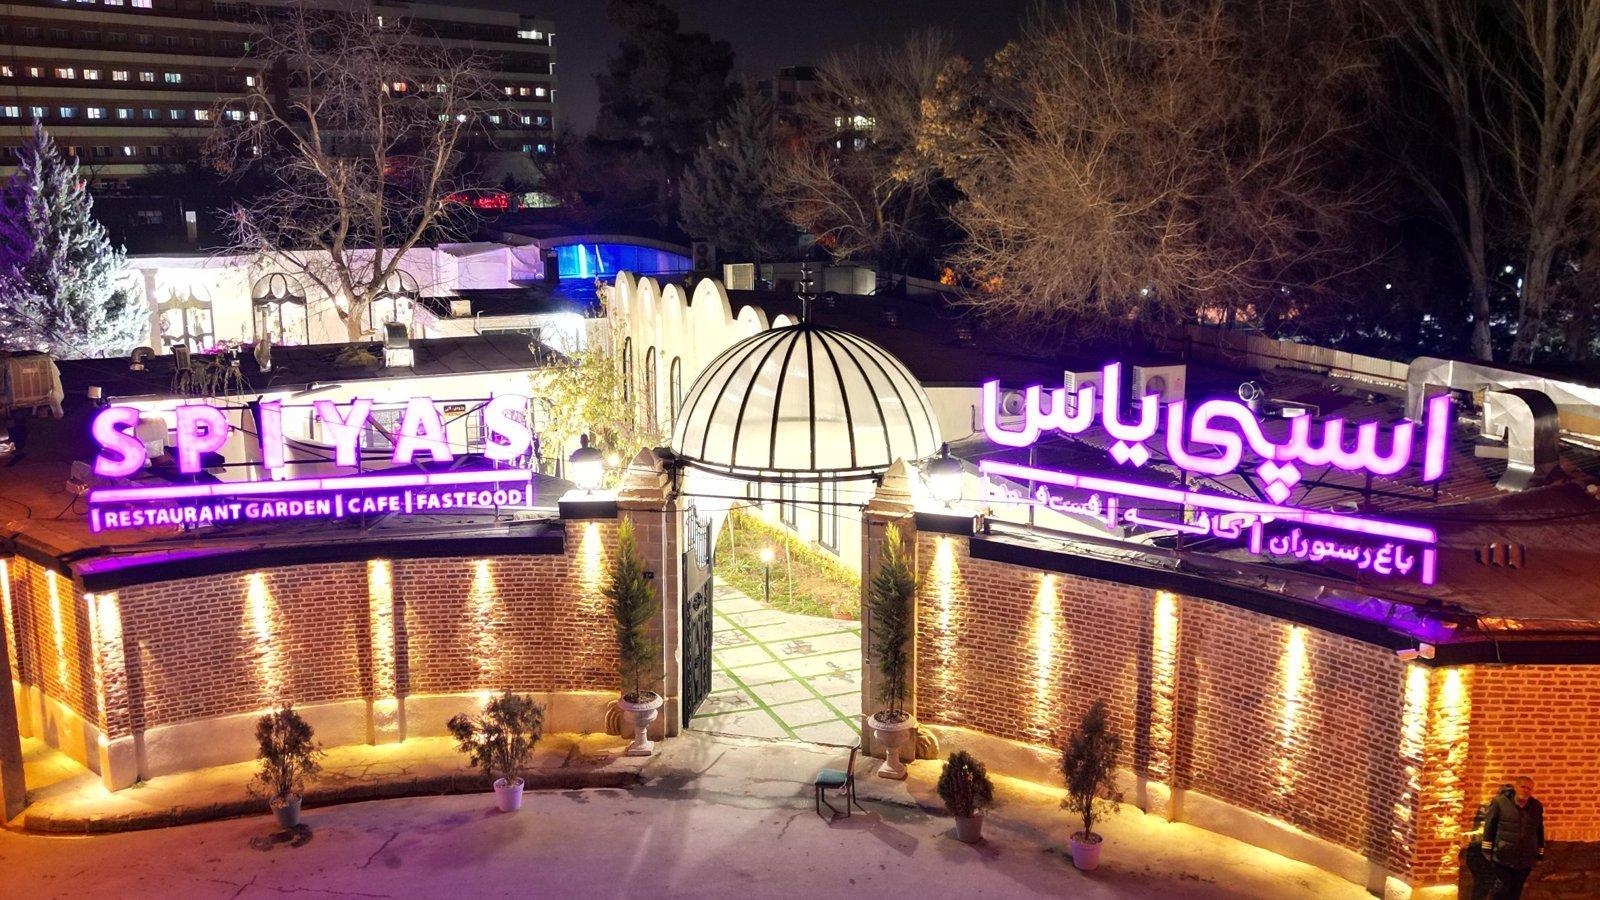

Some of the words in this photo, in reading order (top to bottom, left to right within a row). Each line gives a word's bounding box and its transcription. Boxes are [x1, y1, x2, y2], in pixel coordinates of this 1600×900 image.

[92, 394, 533, 478] SPIYAS
[104, 503, 242, 528] RESTAURANT
[245, 499, 331, 519] GARDEN
[348, 495, 400, 513] CAFE
[416, 488, 523, 510] FASTFOOD
